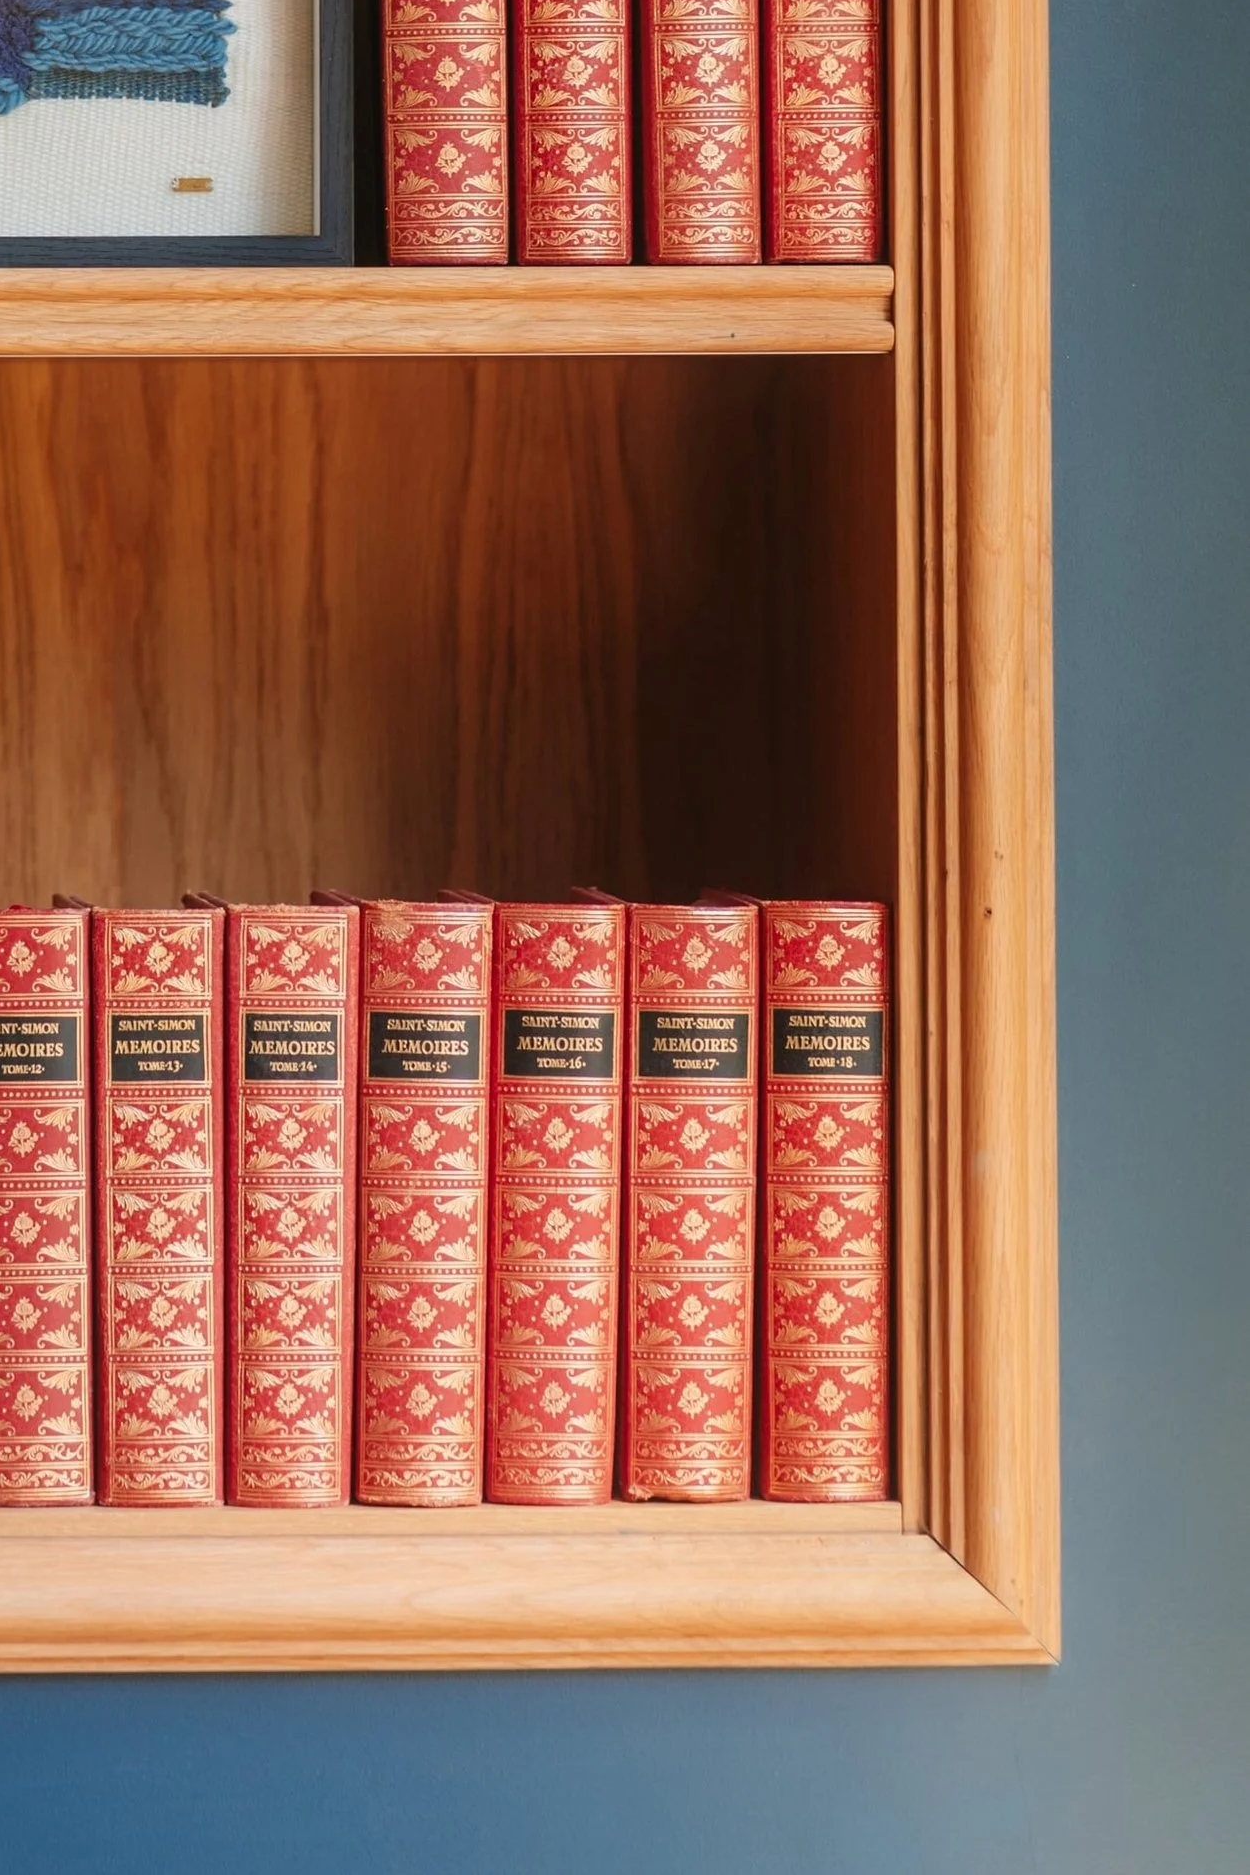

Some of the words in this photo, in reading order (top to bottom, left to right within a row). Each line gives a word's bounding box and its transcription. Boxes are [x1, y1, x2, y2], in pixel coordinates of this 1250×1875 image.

[118, 1020, 195, 1032] SAINT-SIMON
[254, 1020, 331, 1032] SAINT-SIMON
[387, 1019, 465, 1033] SAINT-SIMON
[522, 1016, 599, 1029] SAINT-SIMON
[657, 1017, 735, 1030] SAINT-SIMON
[789, 1015, 866, 1028] SAINT-SIMON
[115, 1039, 201, 1055] MEMOIRES
[250, 1040, 335, 1056] MEMOIRES
[382, 1039, 469, 1056] MEMOIRES
[517, 1036, 603, 1053] MEMOIRES
[652, 1037, 738, 1053] MEMOIRES
[785, 1036, 870, 1051] MEMOIRES
